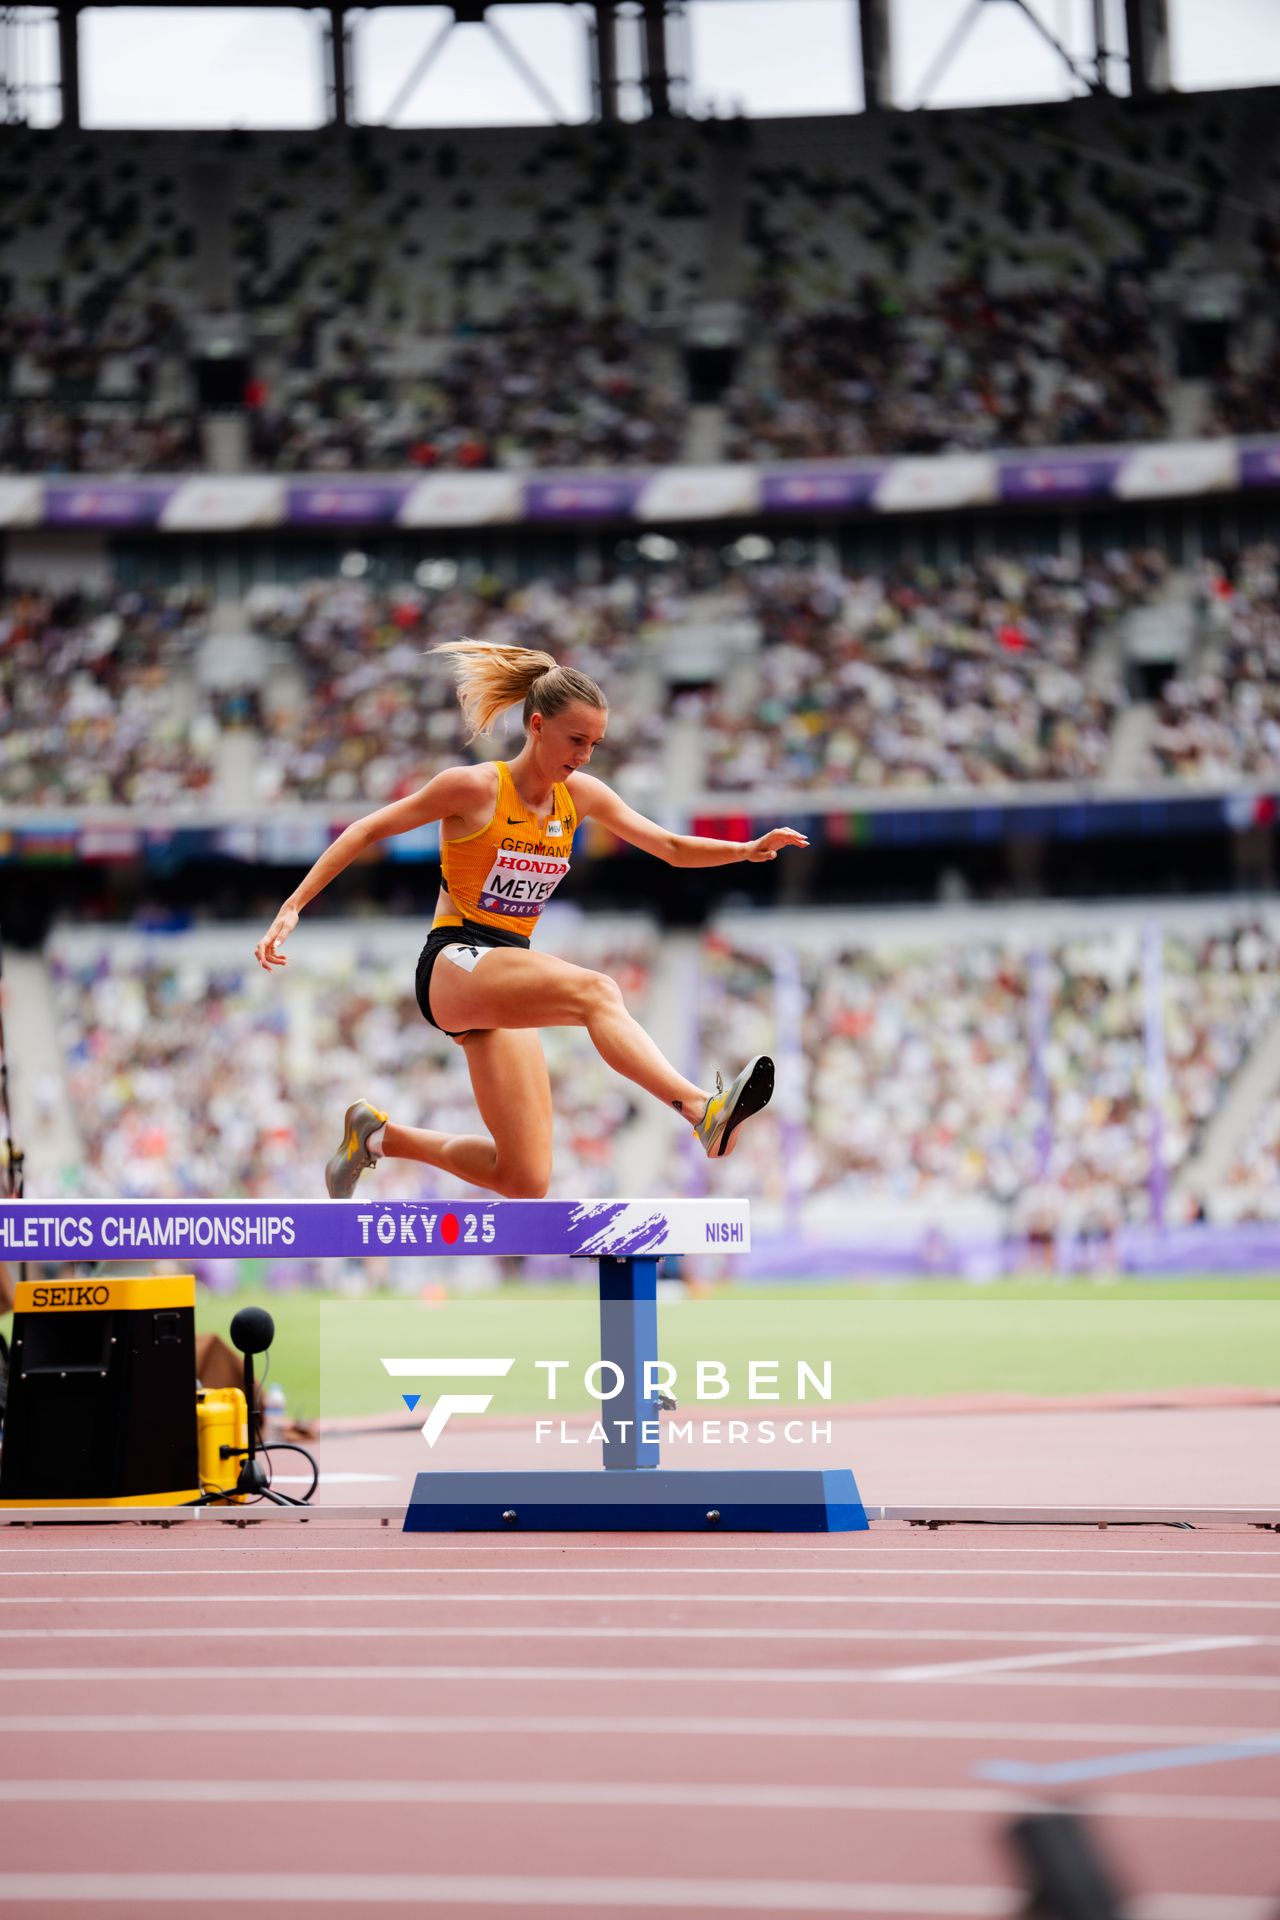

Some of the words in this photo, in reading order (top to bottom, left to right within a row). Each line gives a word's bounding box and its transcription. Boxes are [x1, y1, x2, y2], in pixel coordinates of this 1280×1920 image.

[497, 856, 567, 874] HONDA
[490, 875, 555, 900] MEYER
[101, 1216, 295, 1246] CHAMPIONSHIPS
[705, 1222, 744, 1243] NISHI
[33, 1286, 109, 1307] SEIKO
